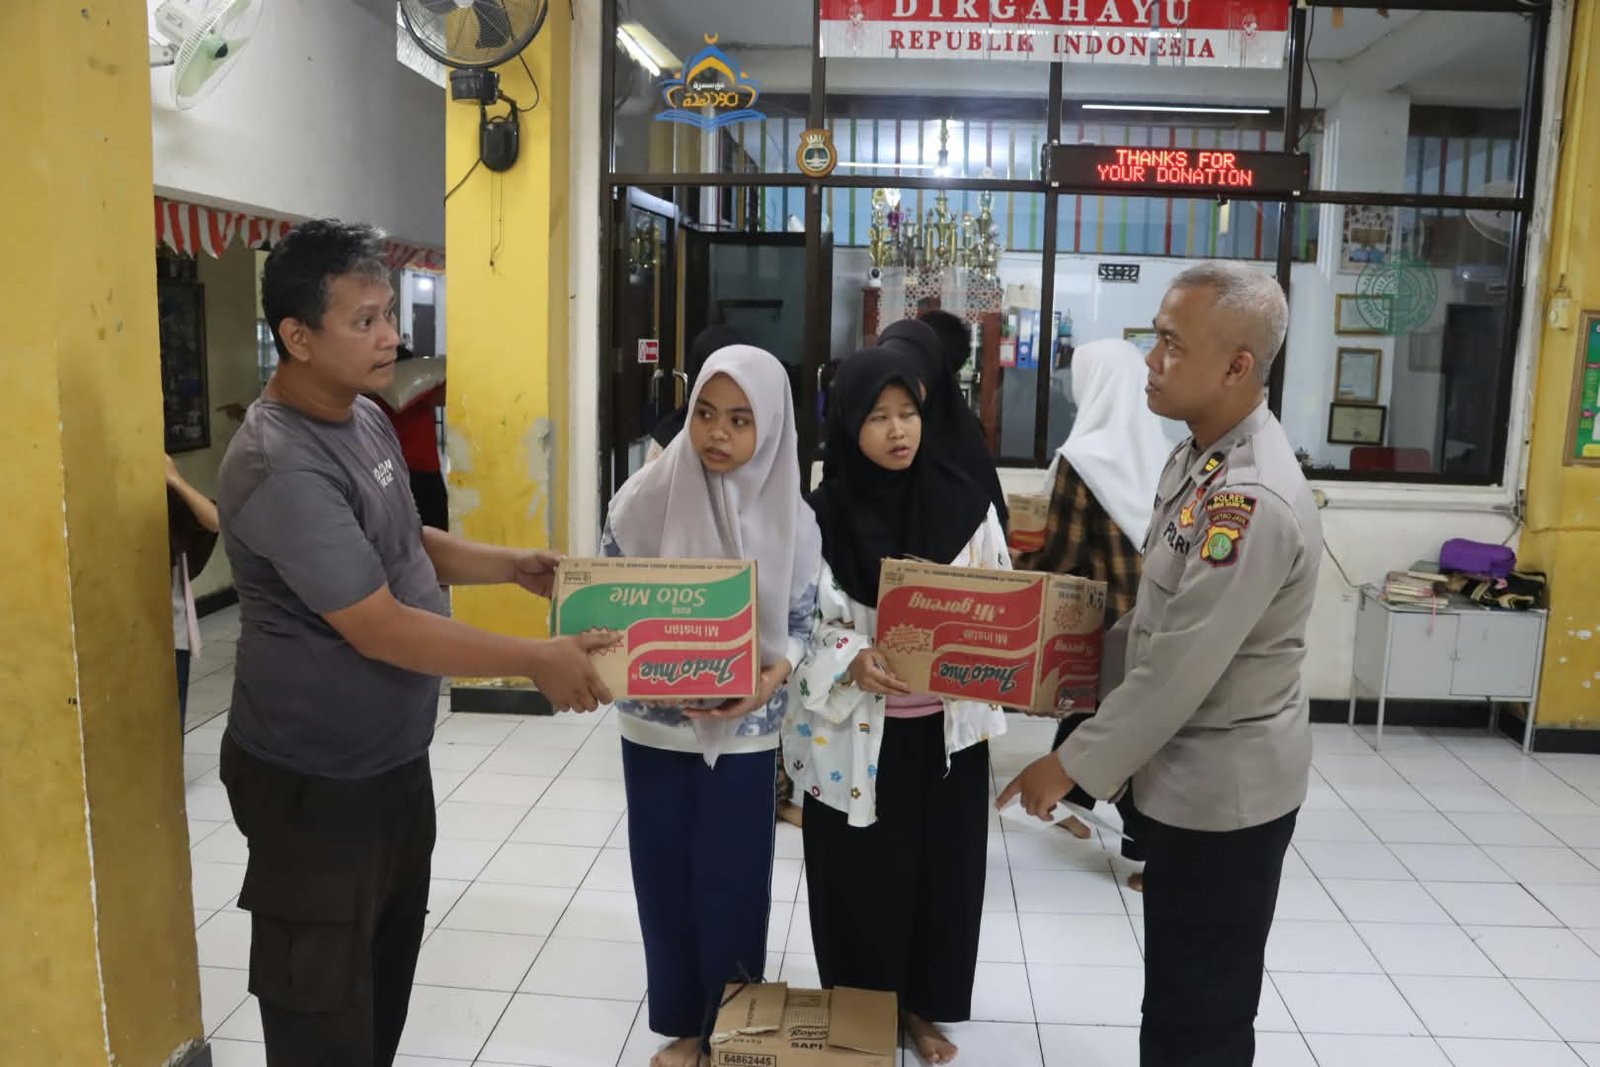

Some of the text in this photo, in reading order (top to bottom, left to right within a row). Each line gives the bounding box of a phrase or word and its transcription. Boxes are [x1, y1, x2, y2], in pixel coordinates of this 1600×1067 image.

[892, 0, 1190, 25] DIRGAHAYU
[889, 29, 1215, 58] REPUBLIK INDONESIA
[1115, 149, 1236, 169] THANKS FOR
[1097, 164, 1253, 186] YOUR DONATION
[1213, 493, 1245, 505] POLRES
[609, 586, 708, 607] Soto Mie
[908, 592, 974, 614] goreng
[664, 623, 719, 638] Mi Instan
[640, 650, 748, 687] Indomie
[939, 660, 1030, 693] Indomie
[790, 1042, 823, 1050] SAPI
[724, 1054, 772, 1066] 64862445
